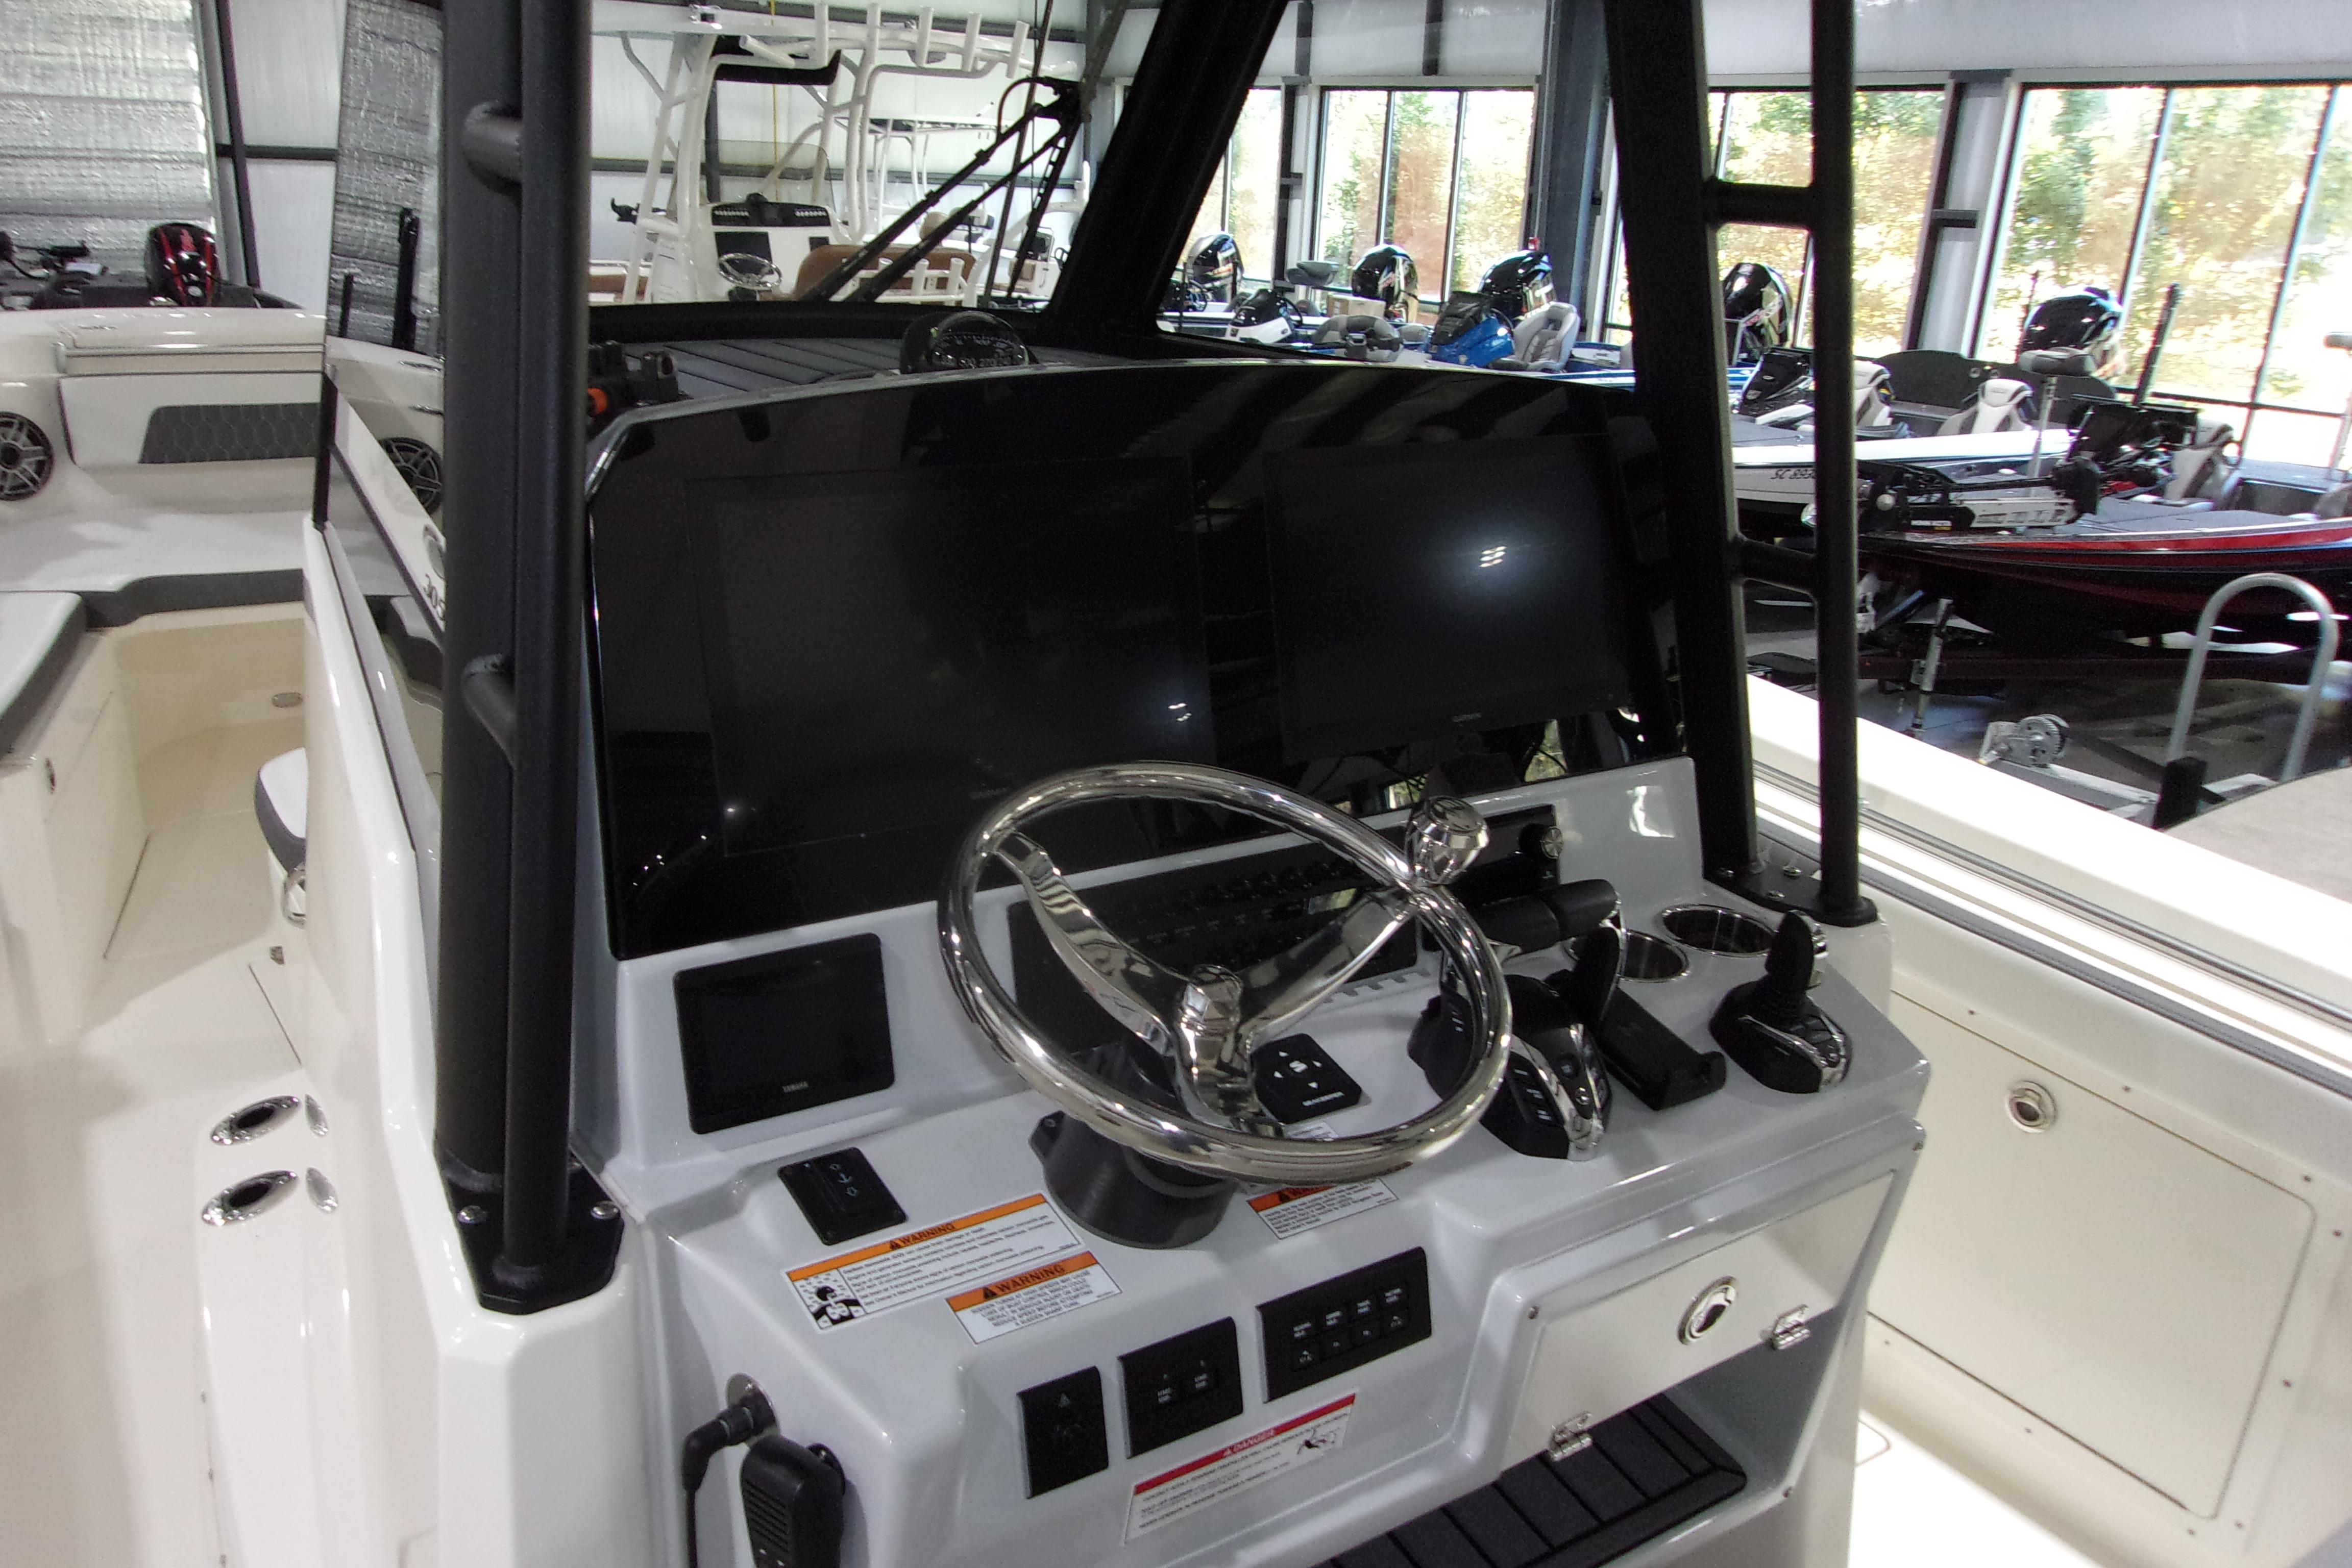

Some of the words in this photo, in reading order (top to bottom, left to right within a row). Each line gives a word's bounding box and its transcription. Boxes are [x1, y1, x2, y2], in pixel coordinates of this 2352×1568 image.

[899, 1222, 955, 1244] WARNING
[996, 1264, 1065, 1292] WARNING
[1233, 1429, 1276, 1451] DANGER
